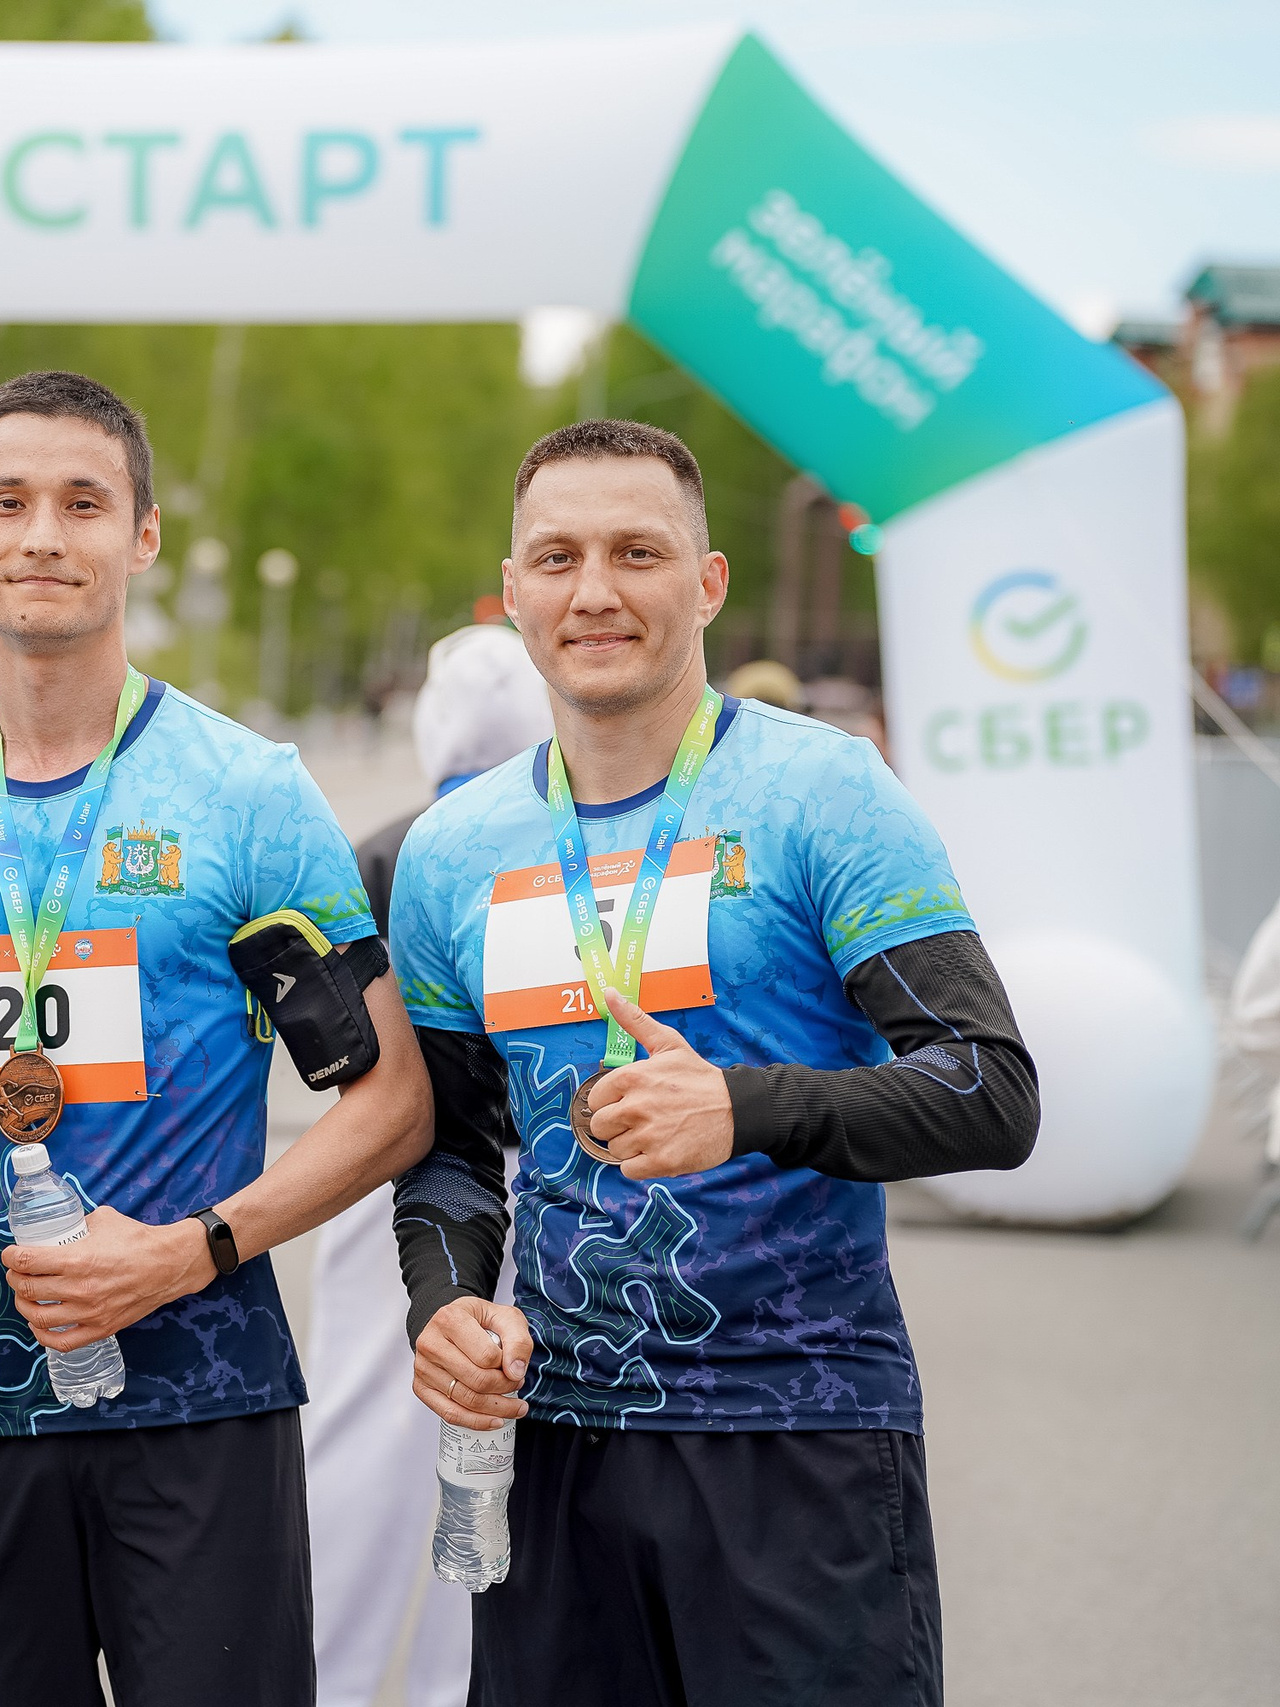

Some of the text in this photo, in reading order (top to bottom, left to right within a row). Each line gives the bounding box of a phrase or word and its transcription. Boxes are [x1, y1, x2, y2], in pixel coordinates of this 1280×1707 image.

[698, 699, 714, 736] 185 лет
[925, 701, 1150, 774] СБЕР
[78, 802, 91, 825] Utair
[565, 838, 575, 859] Utair
[656, 829, 670, 851] Utair
[54, 865, 69, 896] СБЕР
[9, 884, 22, 914] СБЕР
[575, 894, 588, 921] СБЕР
[635, 893, 650, 924] СБЕР
[19, 929, 28, 948] 185
[39, 928, 49, 949] лет
[590, 949, 601, 968] лет
[623, 940, 637, 987] 185 лет
[561, 987, 594, 1015] 21,
[308, 1055, 350, 1083] DEMIX
[34, 1093, 56, 1103] СБЕР
